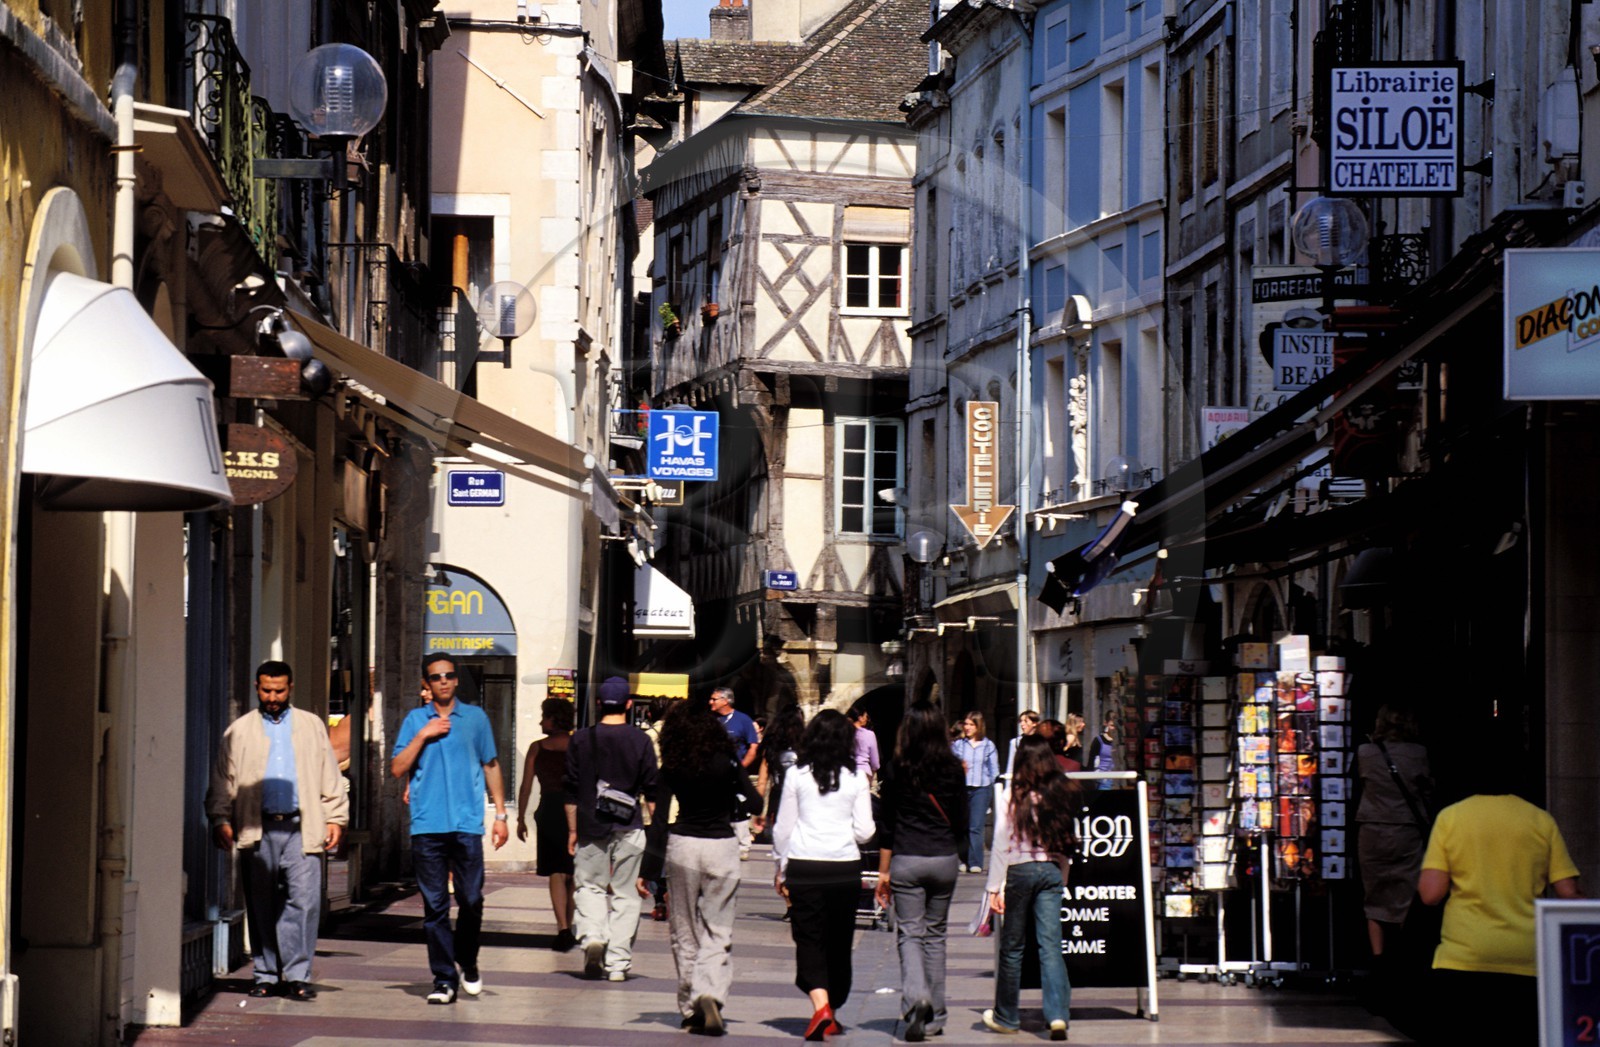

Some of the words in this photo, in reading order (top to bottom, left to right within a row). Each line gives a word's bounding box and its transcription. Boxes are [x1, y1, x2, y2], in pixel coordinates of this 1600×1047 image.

[1336, 71, 1454, 93] Librairie
[1335, 162, 1454, 188] CHATELET
[1315, 356, 1331, 365] DE
[661, 457, 705, 465] HAVAS
[652, 467, 713, 477] VOYAGES
[468, 477, 485, 486] Rue
[429, 637, 494, 650] FANTAISIE
[1075, 886, 1136, 900] PORTER
[1072, 925, 1083, 937] &
